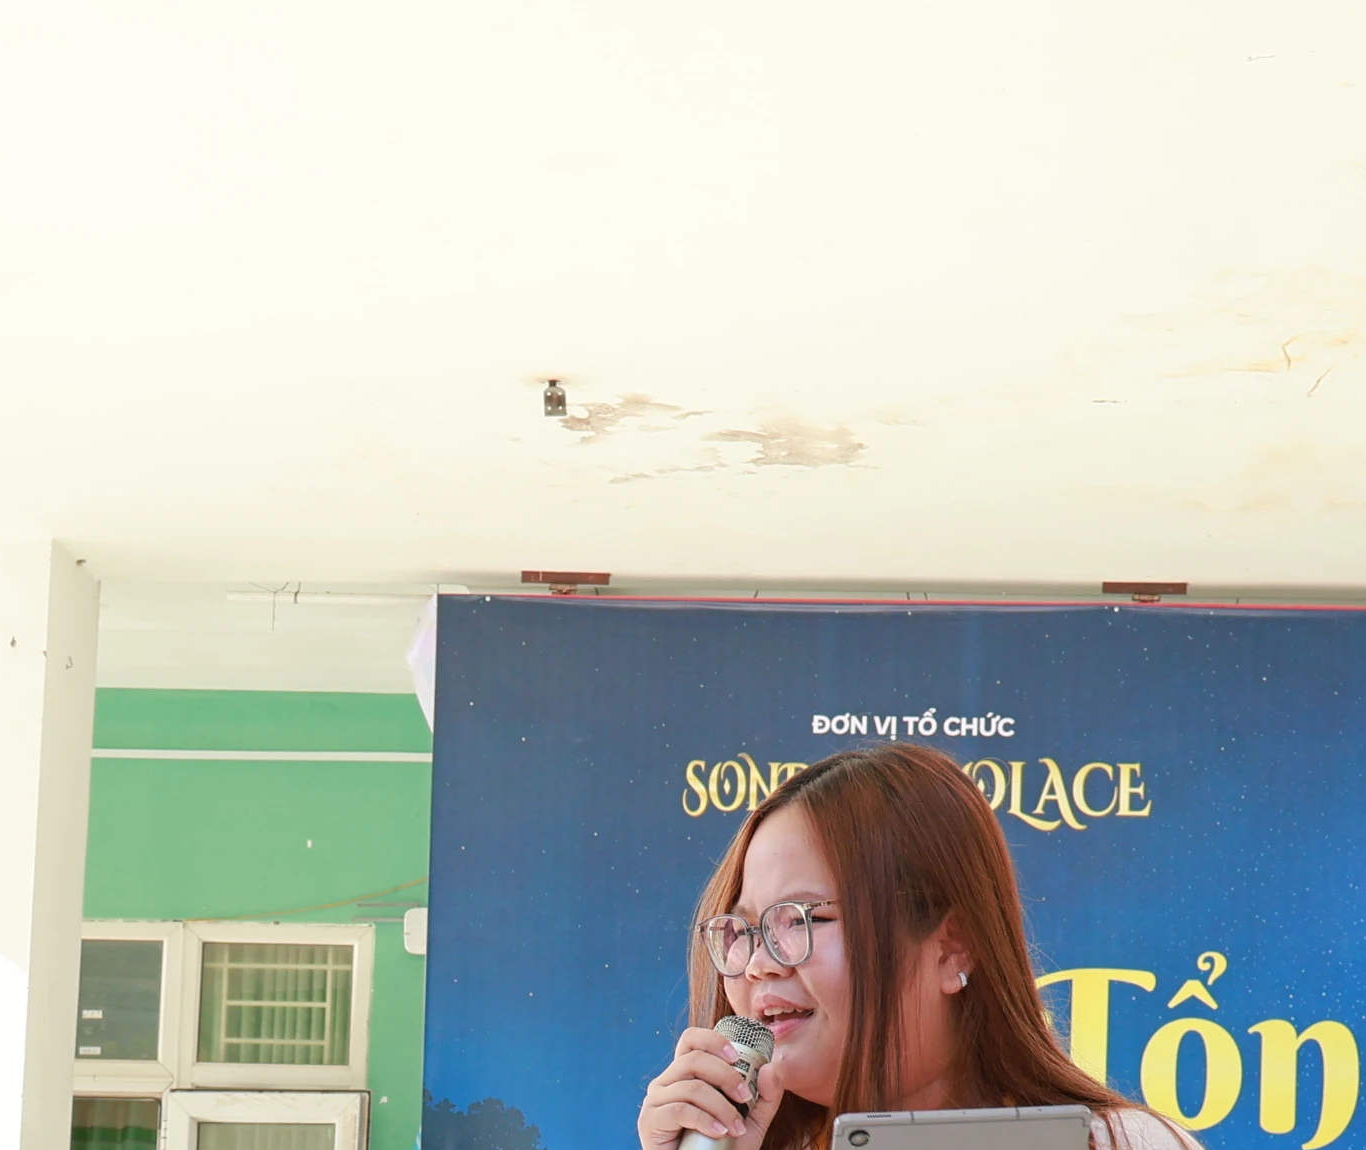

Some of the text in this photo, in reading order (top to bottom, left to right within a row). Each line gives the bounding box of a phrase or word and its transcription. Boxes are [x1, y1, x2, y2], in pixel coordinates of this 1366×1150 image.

[812, 707, 1015, 741] ĐƠN VỊ TỔ CHỨC
[962, 757, 1152, 831] OLACE
